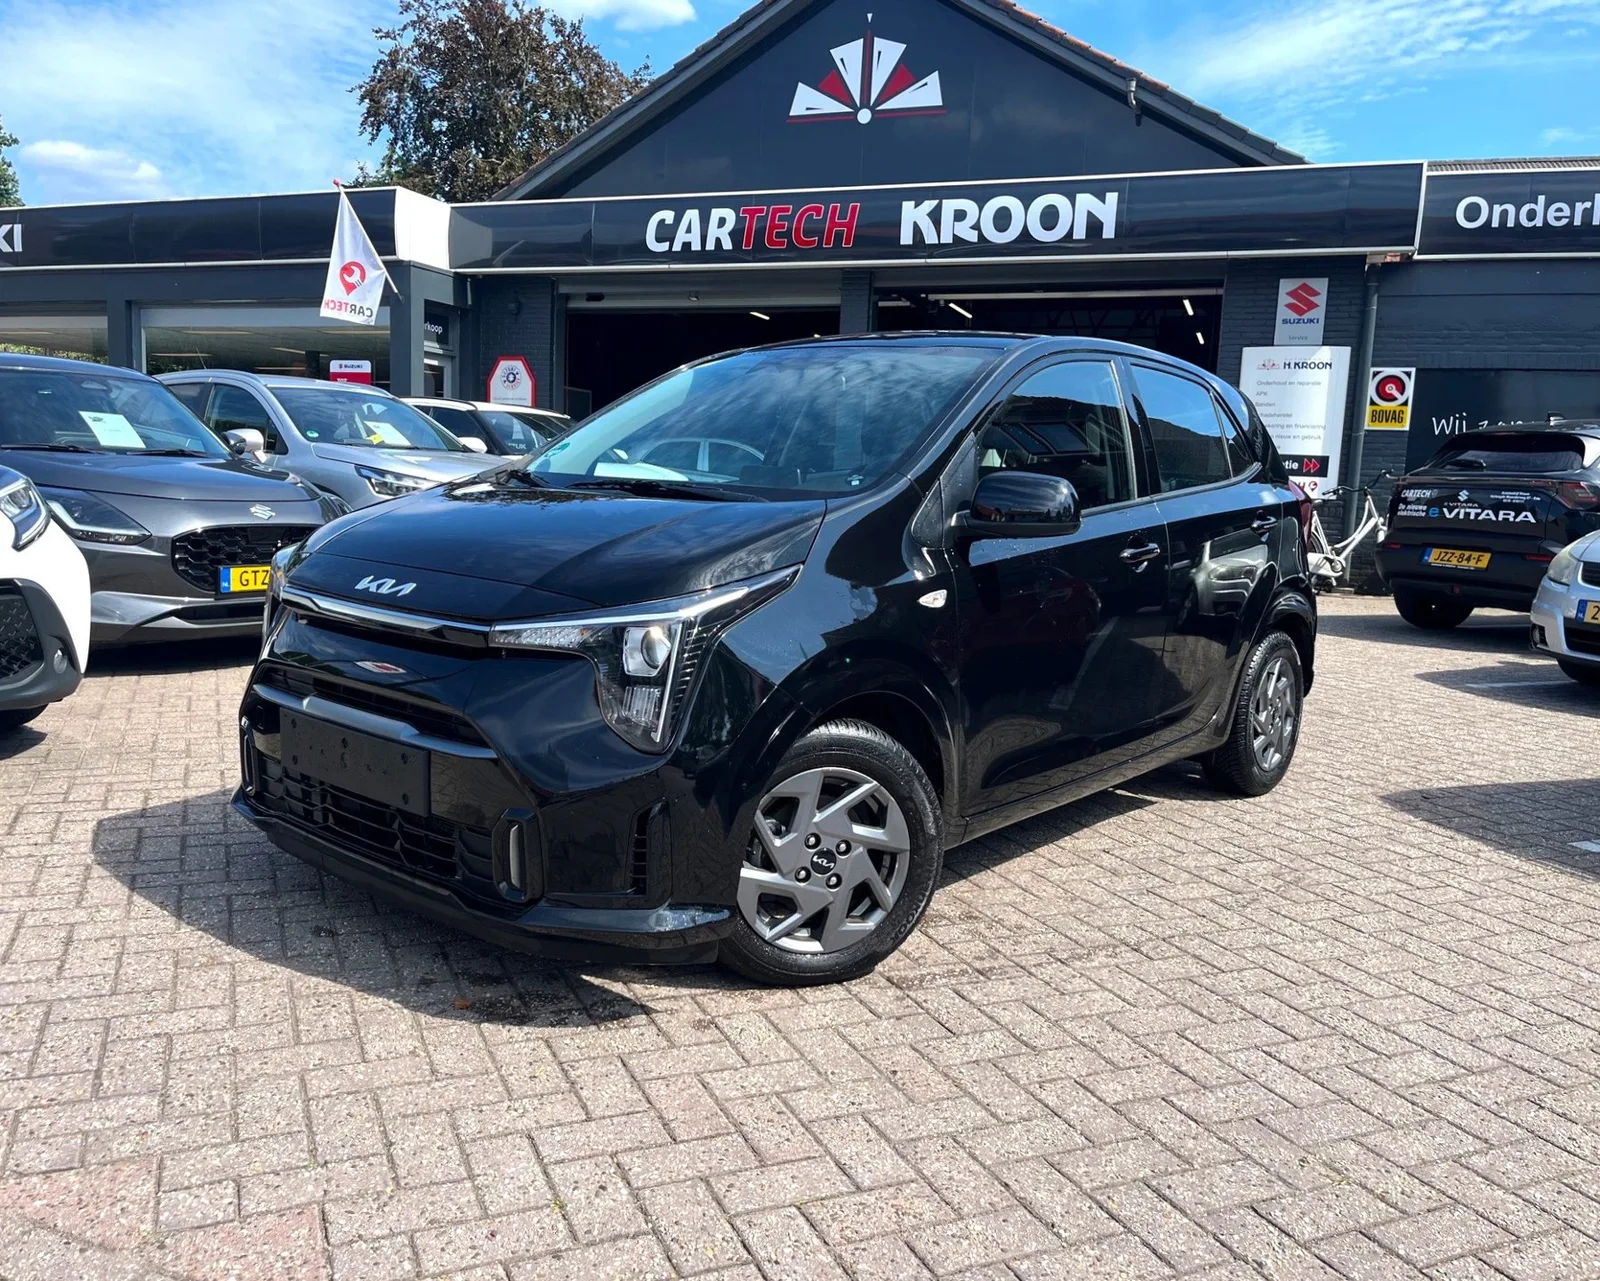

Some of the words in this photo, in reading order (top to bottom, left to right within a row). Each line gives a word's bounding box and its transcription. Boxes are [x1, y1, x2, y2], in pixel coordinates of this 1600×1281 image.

[645, 203, 860, 253] CARTECH
[900, 191, 1119, 245] KROON
[1371, 409, 1404, 423] BOVAG
[1401, 489, 1431, 498] CARTECH
[1429, 507, 1439, 517] e
[1442, 507, 1537, 523] VITARA
[1433, 551, 1485, 565] JZZ-84-F
[239, 570, 270, 587] GTZ
